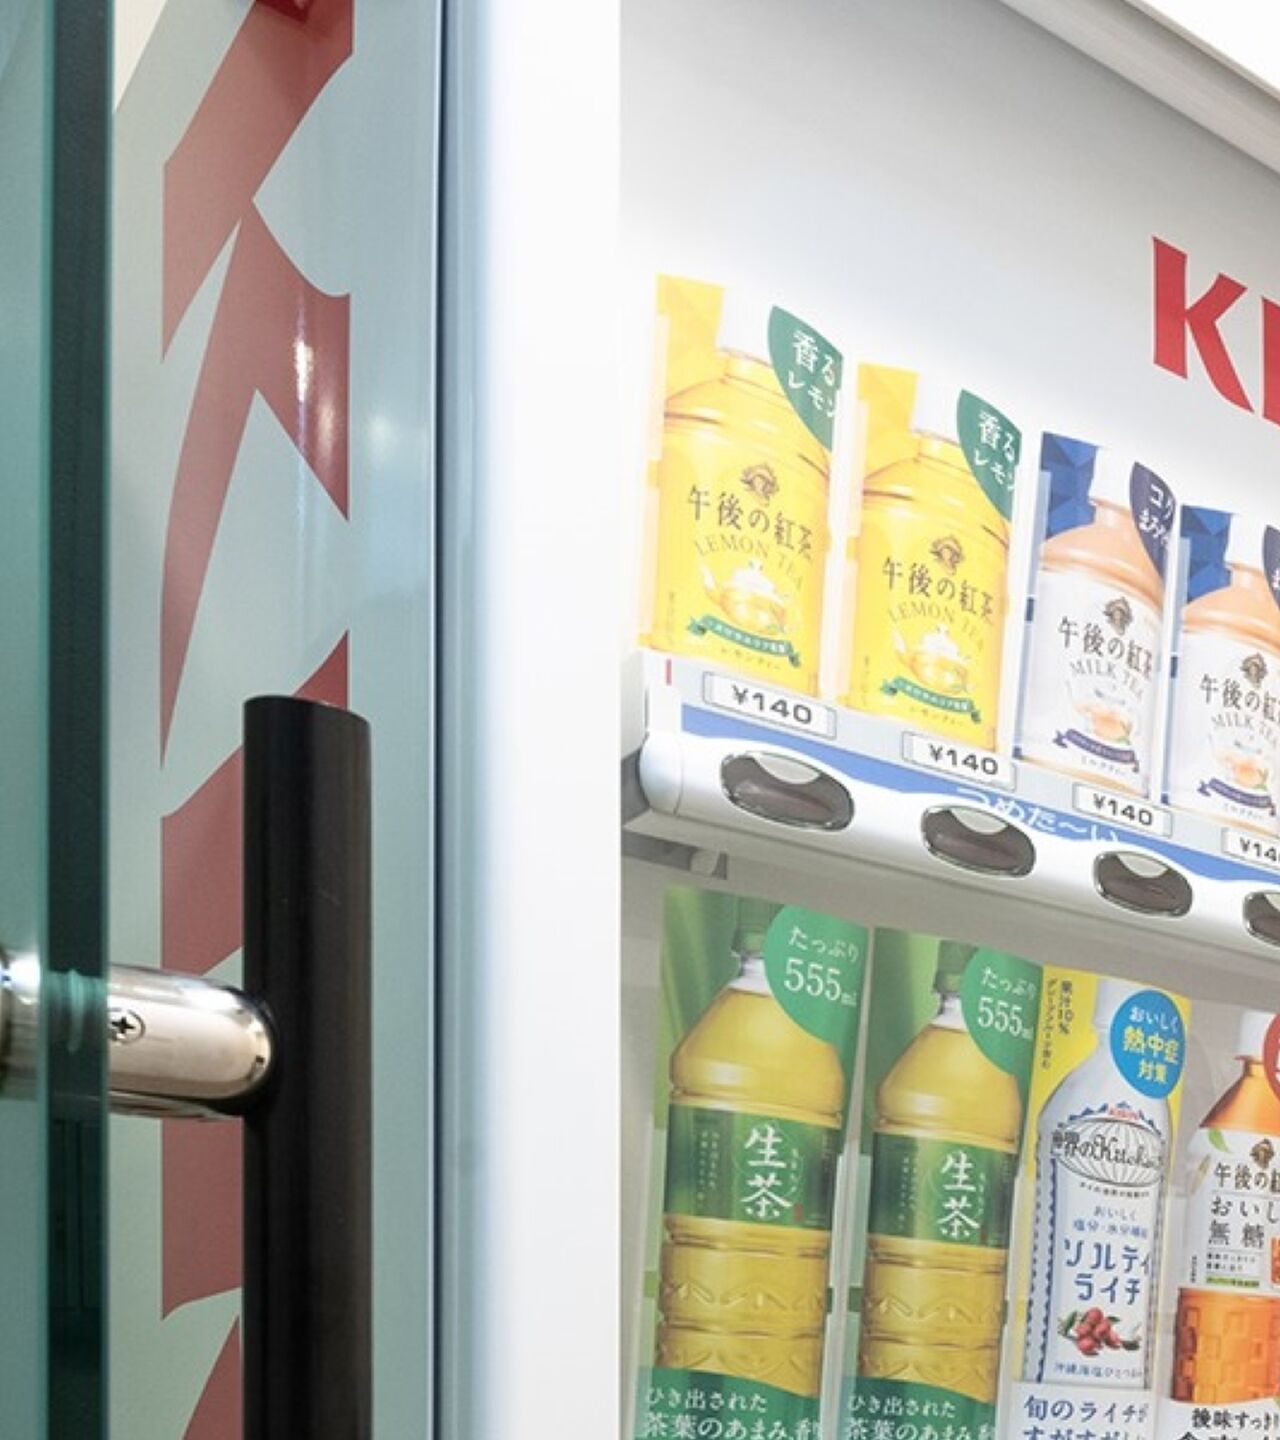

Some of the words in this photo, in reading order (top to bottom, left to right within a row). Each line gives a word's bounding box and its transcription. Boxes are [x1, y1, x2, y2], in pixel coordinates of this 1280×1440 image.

[792, 330, 835, 387] 香る
[731, 684, 814, 727] ¥140
[928, 741, 1000, 776] ¥140
[1091, 792, 1154, 828] ¥140
[787, 925, 860, 965] たっぷり
[981, 965, 1037, 1001] たっぷり
[1129, 1004, 1180, 1031] おいしく
[1123, 1025, 1180, 1065] 熱中症
[1138, 1060, 1167, 1084] 対策
[741, 1122, 793, 1219] 生茶
[936, 1151, 980, 1239] 生茶
[1075, 1273, 1143, 1305] ライチ
[646, 1387, 768, 1414] ひき出された
[848, 1395, 957, 1420] ひき出された
